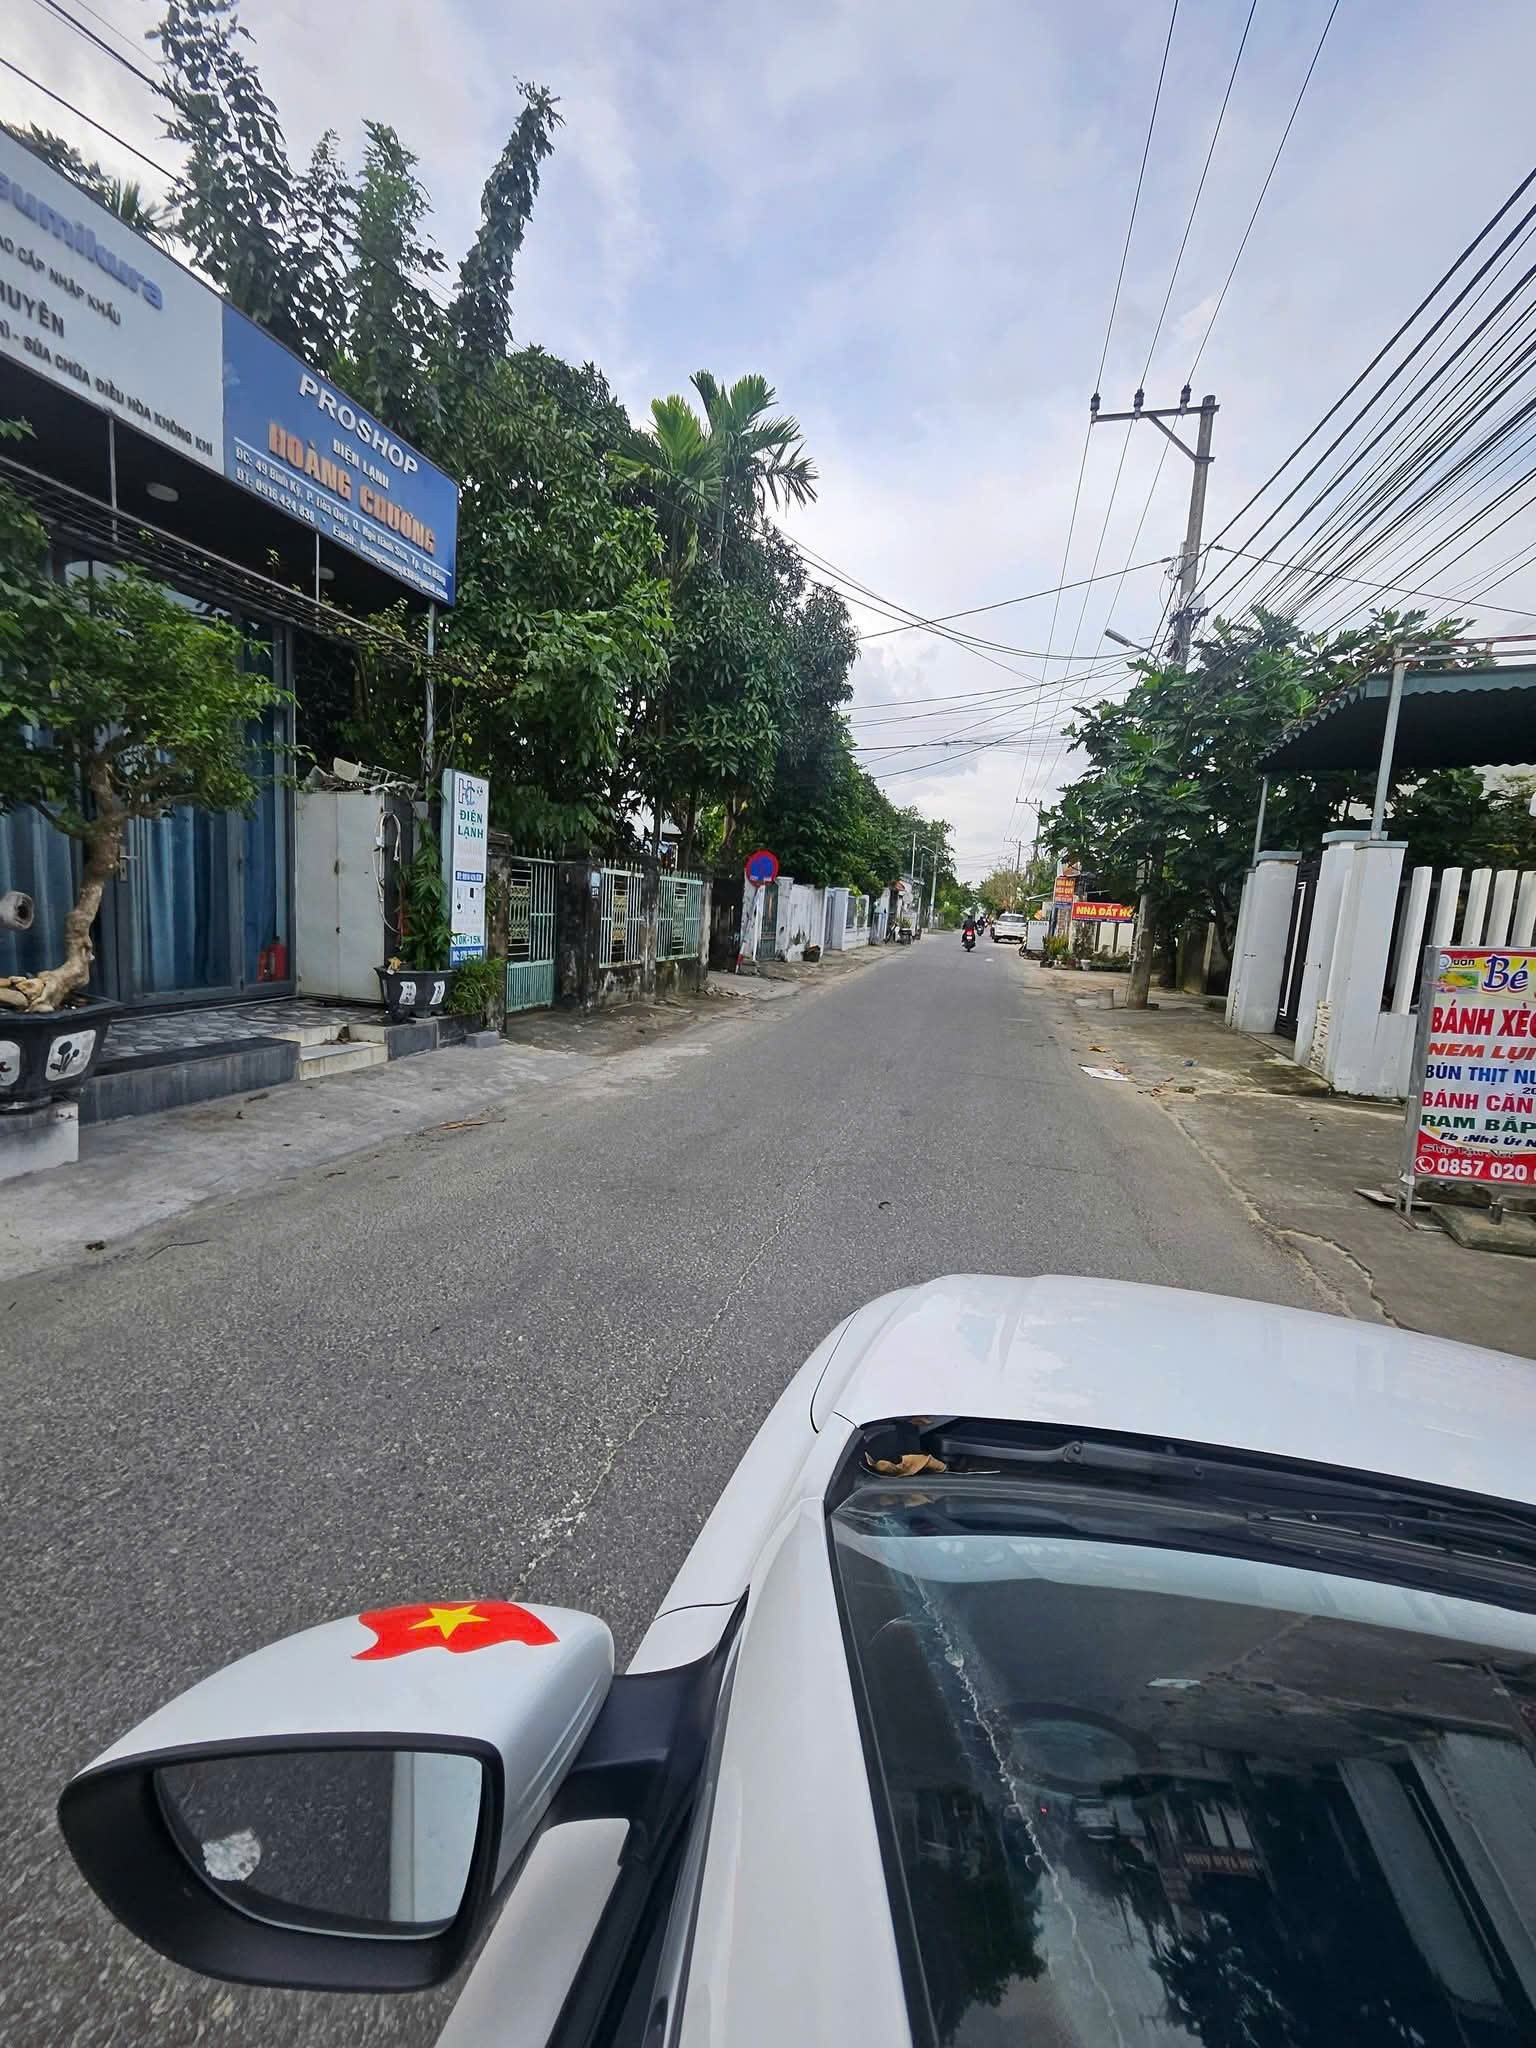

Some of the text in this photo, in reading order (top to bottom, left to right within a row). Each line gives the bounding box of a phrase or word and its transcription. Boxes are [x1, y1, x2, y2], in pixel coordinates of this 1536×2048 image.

[154, 412, 192, 445] KHÔNG
[299, 373, 418, 475] PROSHOP
[333, 438, 389, 489] ĐIỆN LẠNH
[269, 423, 436, 556] HOÀNG CHƯƠNG
[459, 809, 483, 825] ĐIỆN
[457, 825, 484, 840] LẠNH
[1076, 905, 1096, 915] NHÀ
[1098, 904, 1118, 916] ĐẤT
[1483, 954, 1529, 991] Bé
[1431, 999, 1495, 1035] BÁNH
[1428, 1043, 1485, 1058] NEM
[1425, 1062, 1462, 1080] BÚN
[1469, 1066, 1509, 1086] THỊT
[1423, 1089, 1533, 1114] BÁNH CĂN
[1420, 1114, 1536, 1134] RAM BẮP
[1440, 1132, 1459, 1141] Fb
[1437, 1158, 1528, 1180] 0857 020
